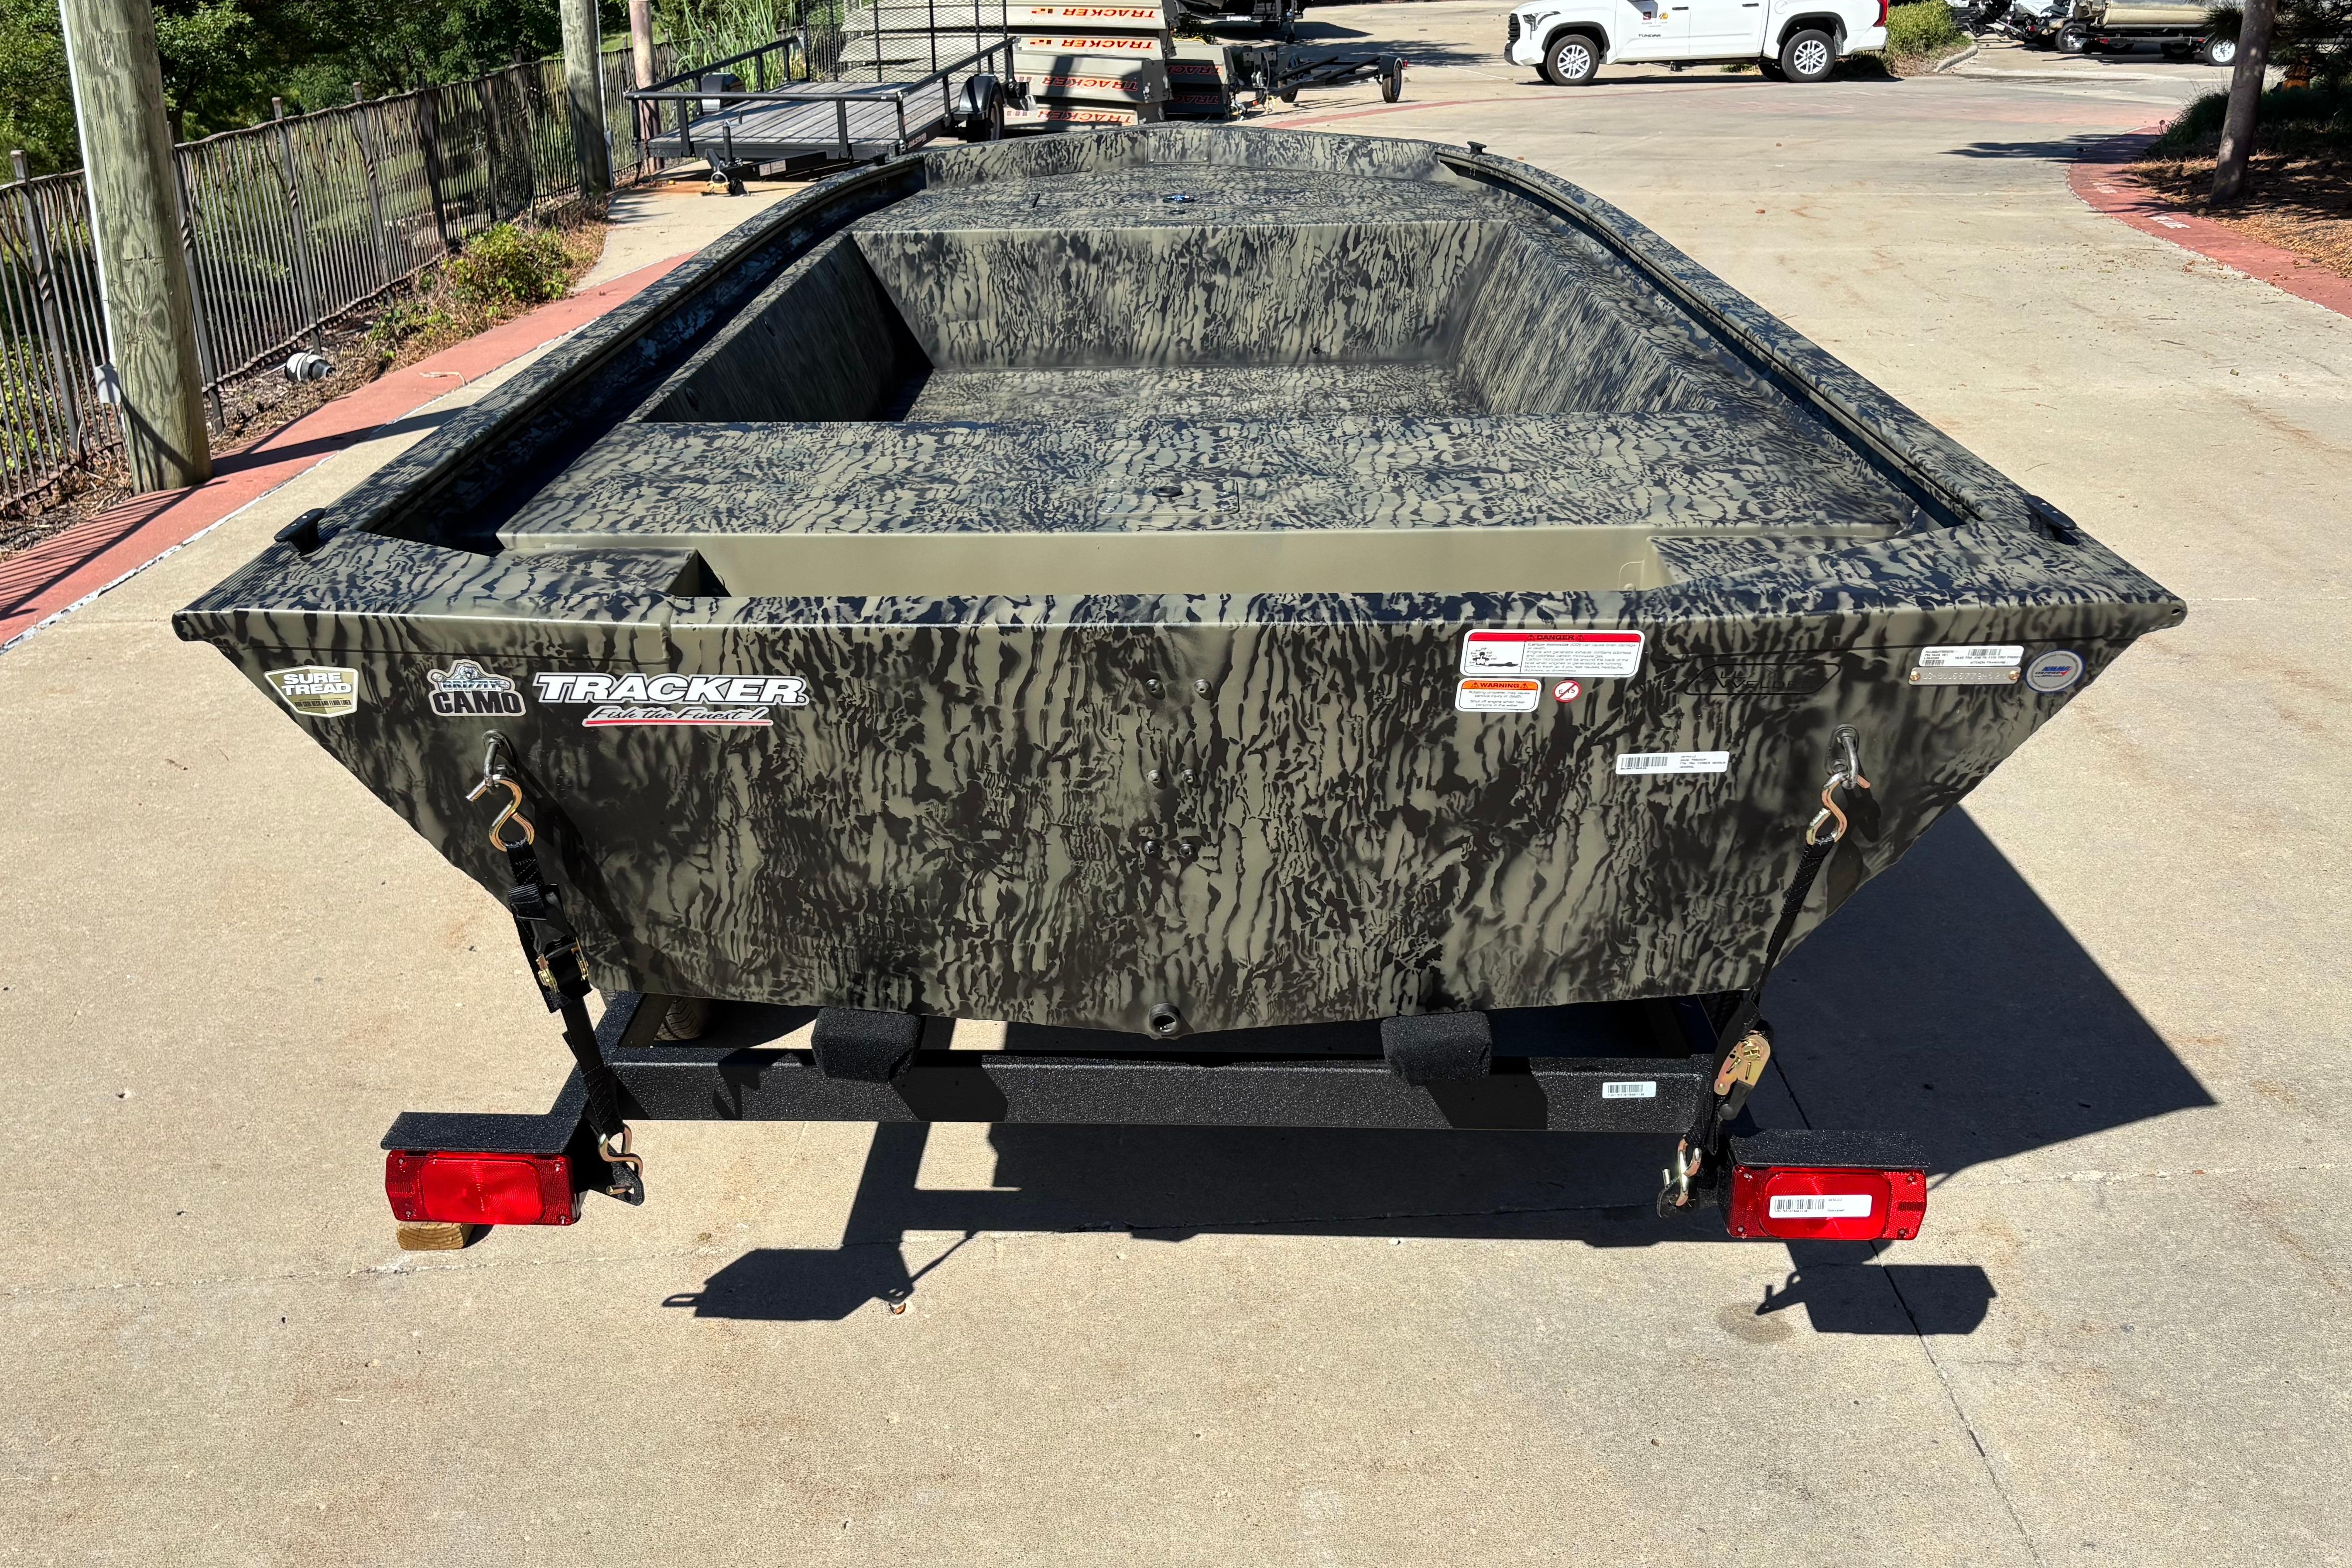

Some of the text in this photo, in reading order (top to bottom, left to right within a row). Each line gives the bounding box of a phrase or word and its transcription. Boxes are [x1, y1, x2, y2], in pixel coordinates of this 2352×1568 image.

[1063, 8, 1155, 18] TRACKER
[1061, 39, 1152, 49] TRACKER
[1041, 77, 1138, 91] TRACKER
[1038, 111, 1132, 124] TRACKER
[283, 672, 342, 685] SURE
[281, 683, 352, 696] TREAD
[538, 675, 801, 703] TRACKER
[433, 690, 522, 713] CAMO
[597, 708, 637, 719] Fish
[640, 707, 671, 719] the
